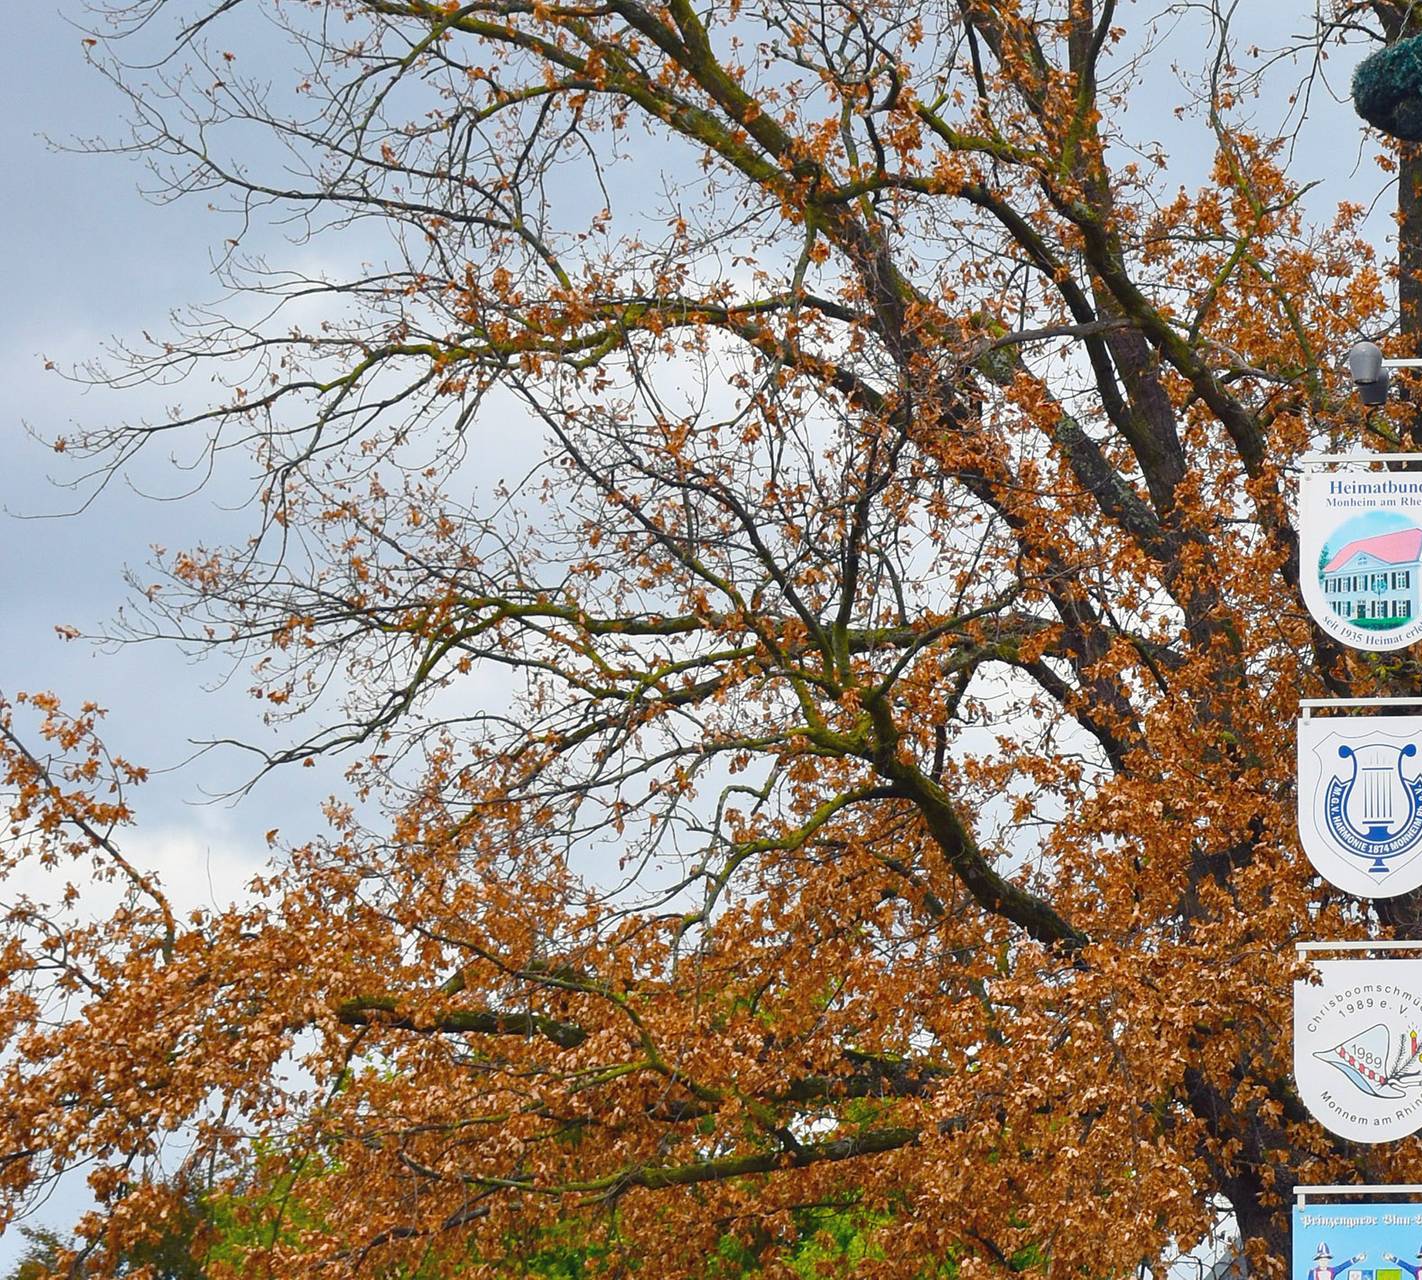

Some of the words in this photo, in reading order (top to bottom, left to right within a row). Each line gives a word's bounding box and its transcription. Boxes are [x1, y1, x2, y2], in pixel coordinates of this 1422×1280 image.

[1326, 497, 1376, 507] Monheim
[1380, 499, 1396, 507] am
[1322, 614, 1340, 631] seit
[1340, 627, 1363, 643] 1935
[1365, 634, 1404, 646] Heimat
[1330, 786, 1342, 815] M.G.V.
[1332, 815, 1368, 852] HARMONIE
[1390, 817, 1422, 851] MONHEIM
[1368, 845, 1390, 854] 1874
[1338, 998, 1374, 1018] 1989
[1352, 1044, 1382, 1069] 1989
[1320, 1090, 1368, 1126] Monnem
[1373, 1116, 1392, 1126] am
[1301, 1215, 1378, 1229] Prinzengarde
